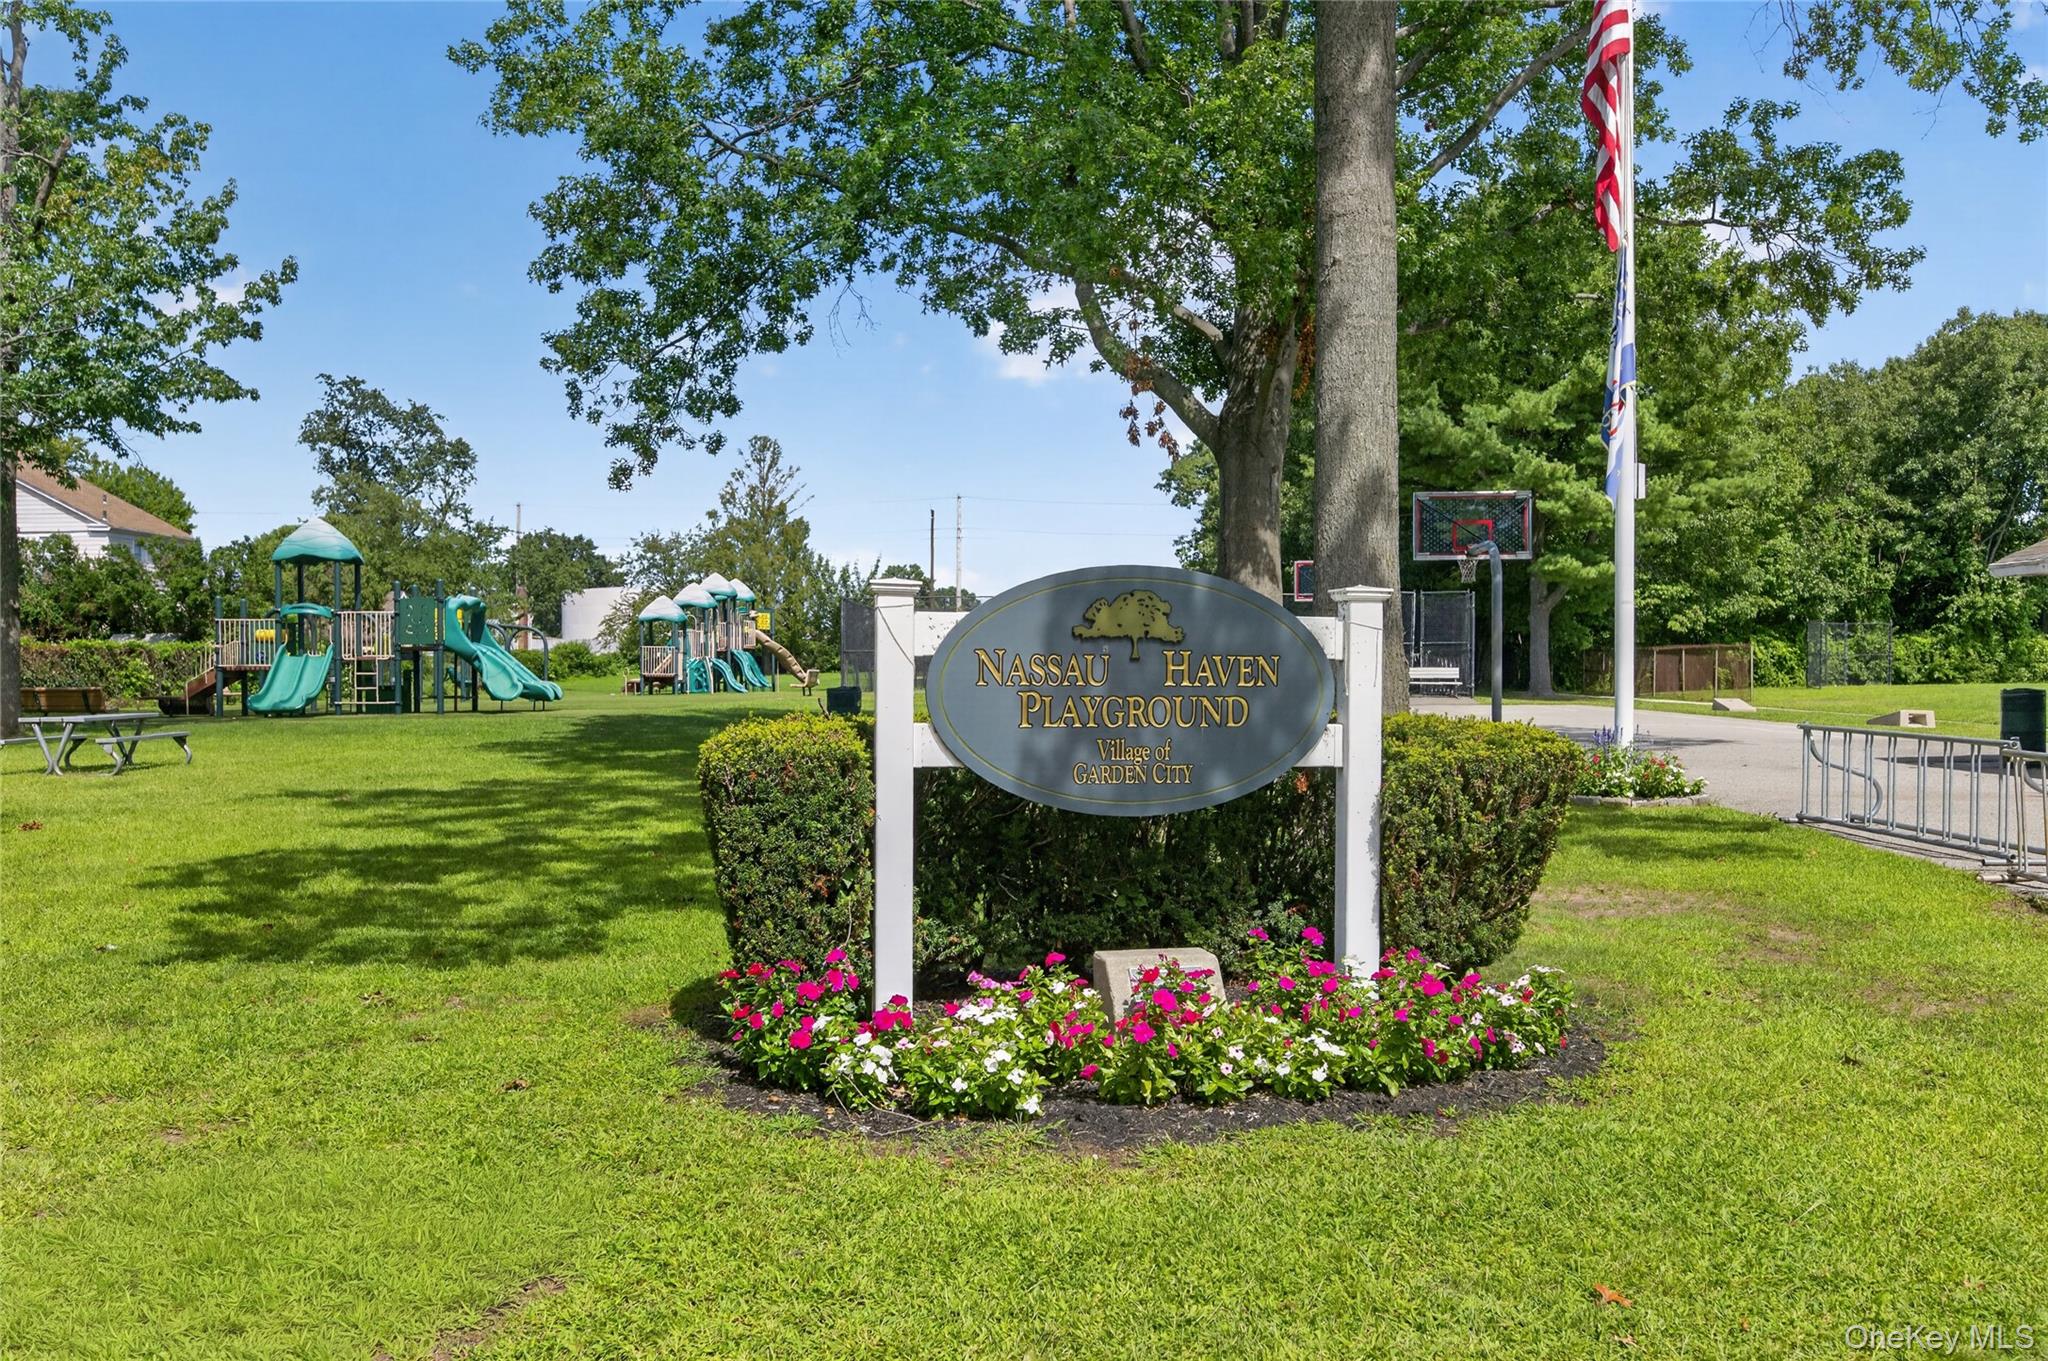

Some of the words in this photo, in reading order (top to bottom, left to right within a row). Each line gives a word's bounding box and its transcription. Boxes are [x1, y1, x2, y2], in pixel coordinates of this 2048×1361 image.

[975, 648, 1110, 687] NASSAU
[1163, 650, 1280, 687] HAVEN
[1018, 691, 1250, 729] PLAYGROUND
[1097, 738, 1151, 763] Village
[1154, 739, 1171, 761] of
[1073, 763, 1147, 784] GARDEN
[1152, 763, 1194, 784] CITY
